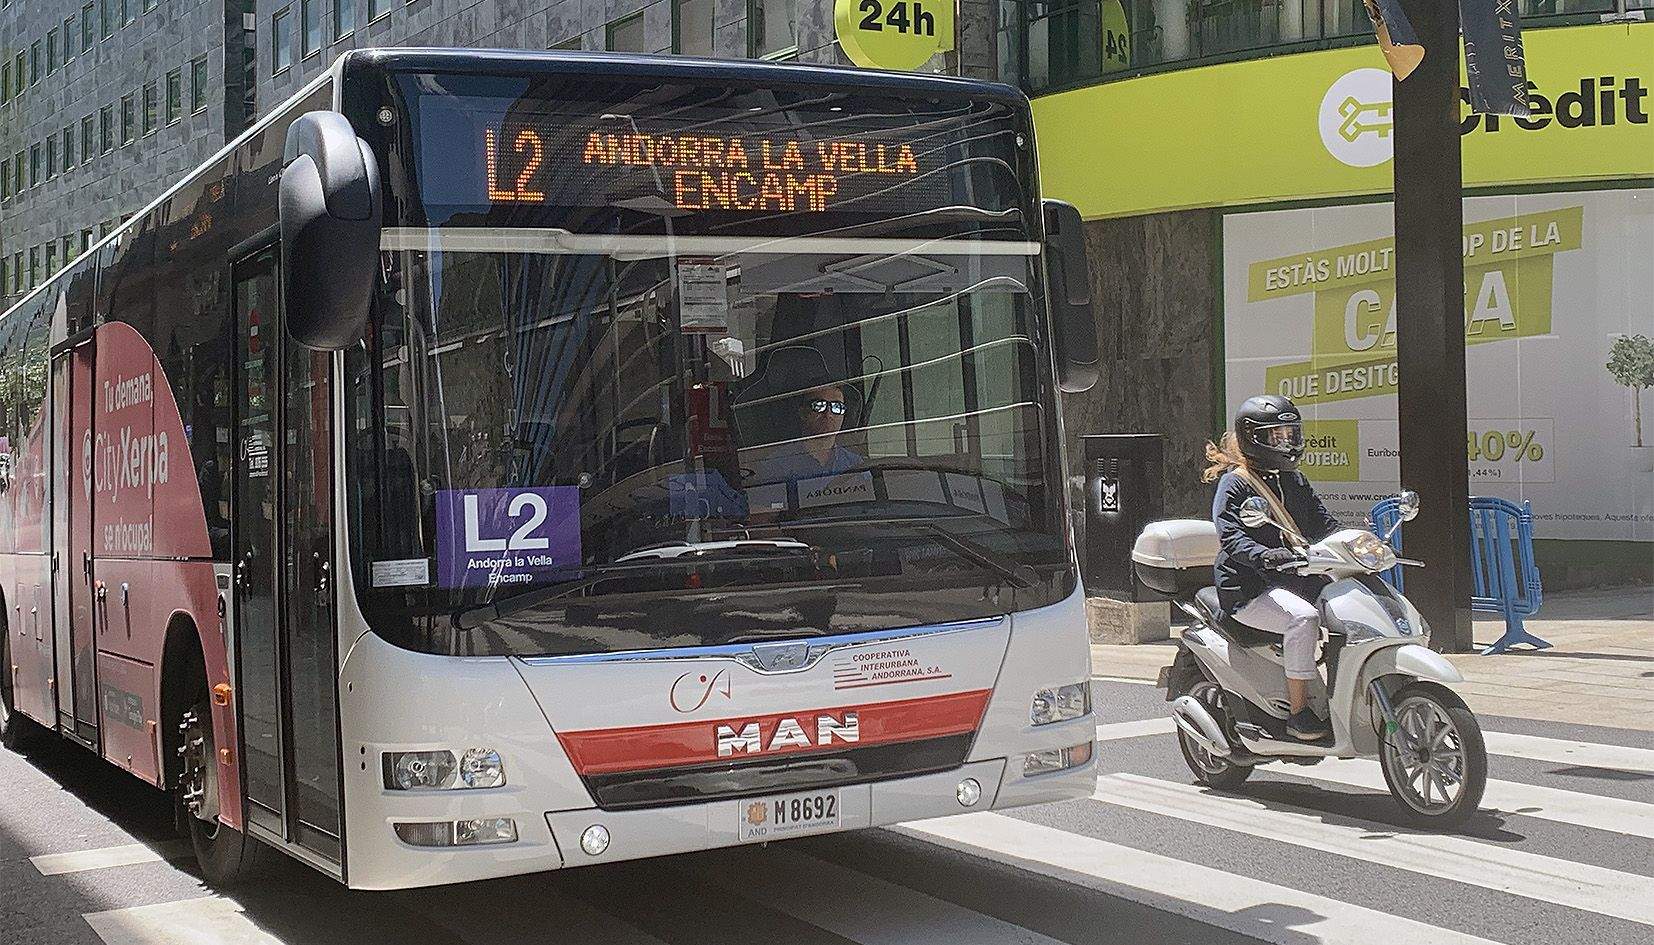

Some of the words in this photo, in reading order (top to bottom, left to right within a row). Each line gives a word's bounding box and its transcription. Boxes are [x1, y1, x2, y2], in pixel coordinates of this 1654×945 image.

[859, 0, 935, 36] 24h
[1460, 77, 1648, 137] èdit
[485, 128, 545, 202] L2
[583, 132, 748, 167] ANDORRA
[764, 139, 805, 171] LA
[817, 141, 918, 174] VELLA
[675, 170, 838, 212] ENCAMP
[1265, 257, 1331, 291] ESTÀS
[1336, 247, 1393, 278] MOLT
[1491, 226, 1523, 254] DE
[1529, 221, 1561, 248] LA
[104, 380, 114, 413] Tu
[116, 373, 154, 412] demana,
[1279, 374, 1319, 398] QUE
[1304, 434, 1337, 448] rèdit
[94, 426, 169, 503] CityXerpa
[1300, 451, 1350, 467] POTECA
[463, 492, 549, 552] L2
[104, 525, 113, 551] se
[467, 558, 512, 569] Andorra
[514, 556, 524, 567] la
[527, 555, 553, 566] Vella
[489, 573, 533, 584] Encamp
[852, 649, 911, 662] COOPERATIVA
[860, 659, 919, 671] INTERURBANA
[871, 668, 925, 680] ANDORRANA,
[926, 666, 942, 674] S.A.
[716, 712, 860, 758] MAN
[774, 800, 786, 824] M
[790, 794, 836, 822] 8692
[748, 827, 768, 837] AND
